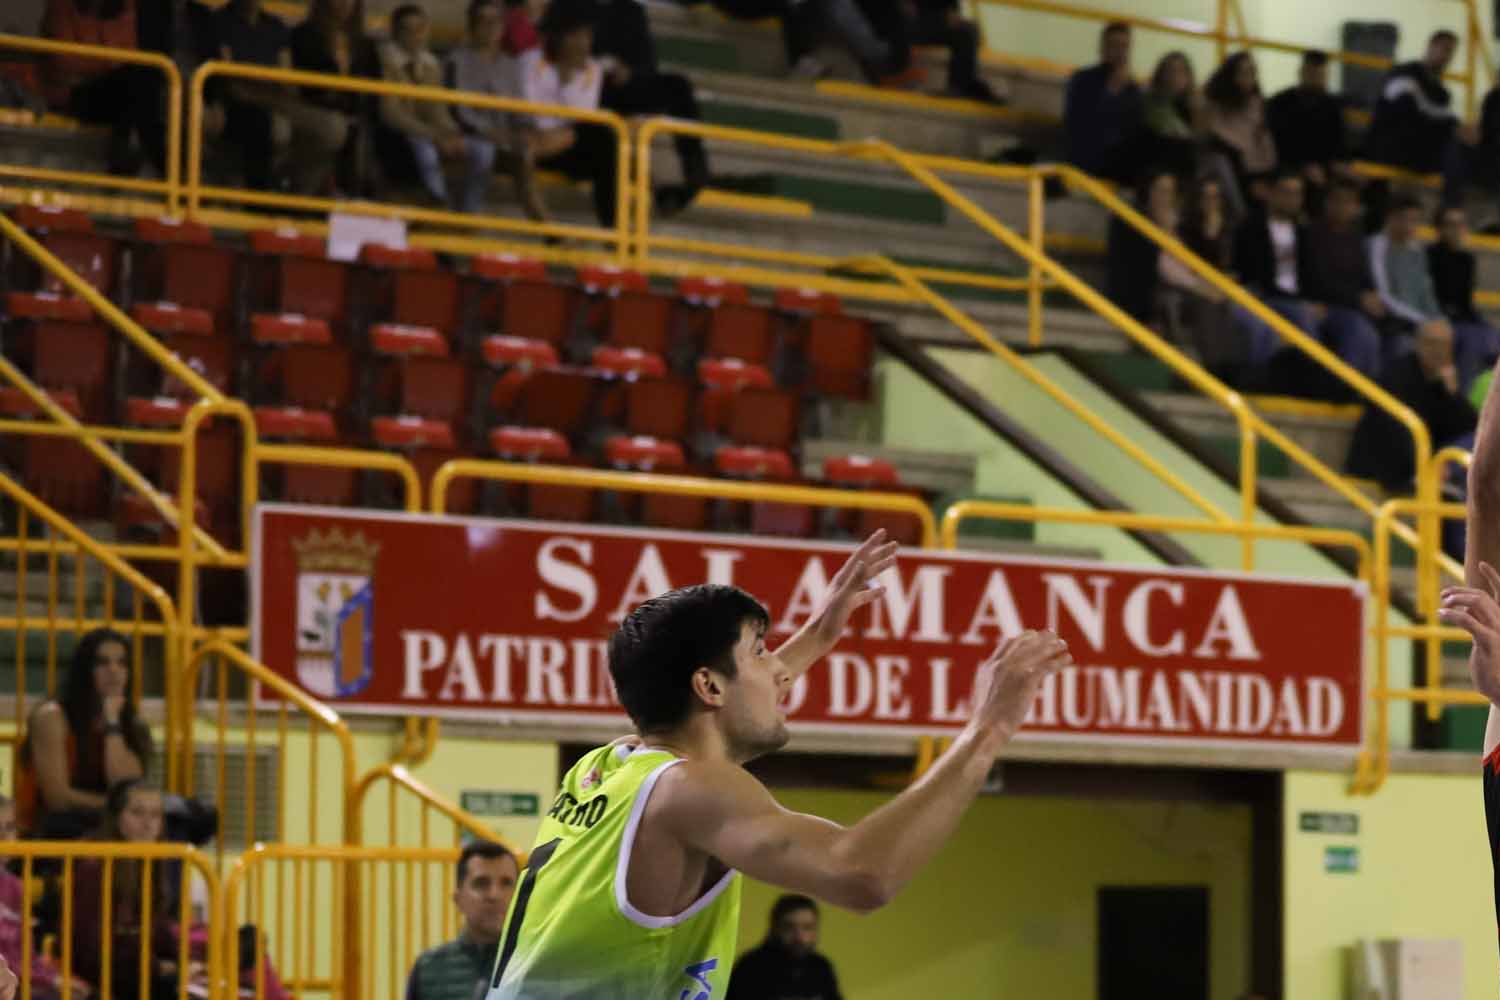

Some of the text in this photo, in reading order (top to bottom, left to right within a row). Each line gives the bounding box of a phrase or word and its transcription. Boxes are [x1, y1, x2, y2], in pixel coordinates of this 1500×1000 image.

[400, 631, 808, 716] PATRIO
[827, 653, 910, 719] DE
[1023, 665, 1343, 737] HUMANIDAD
